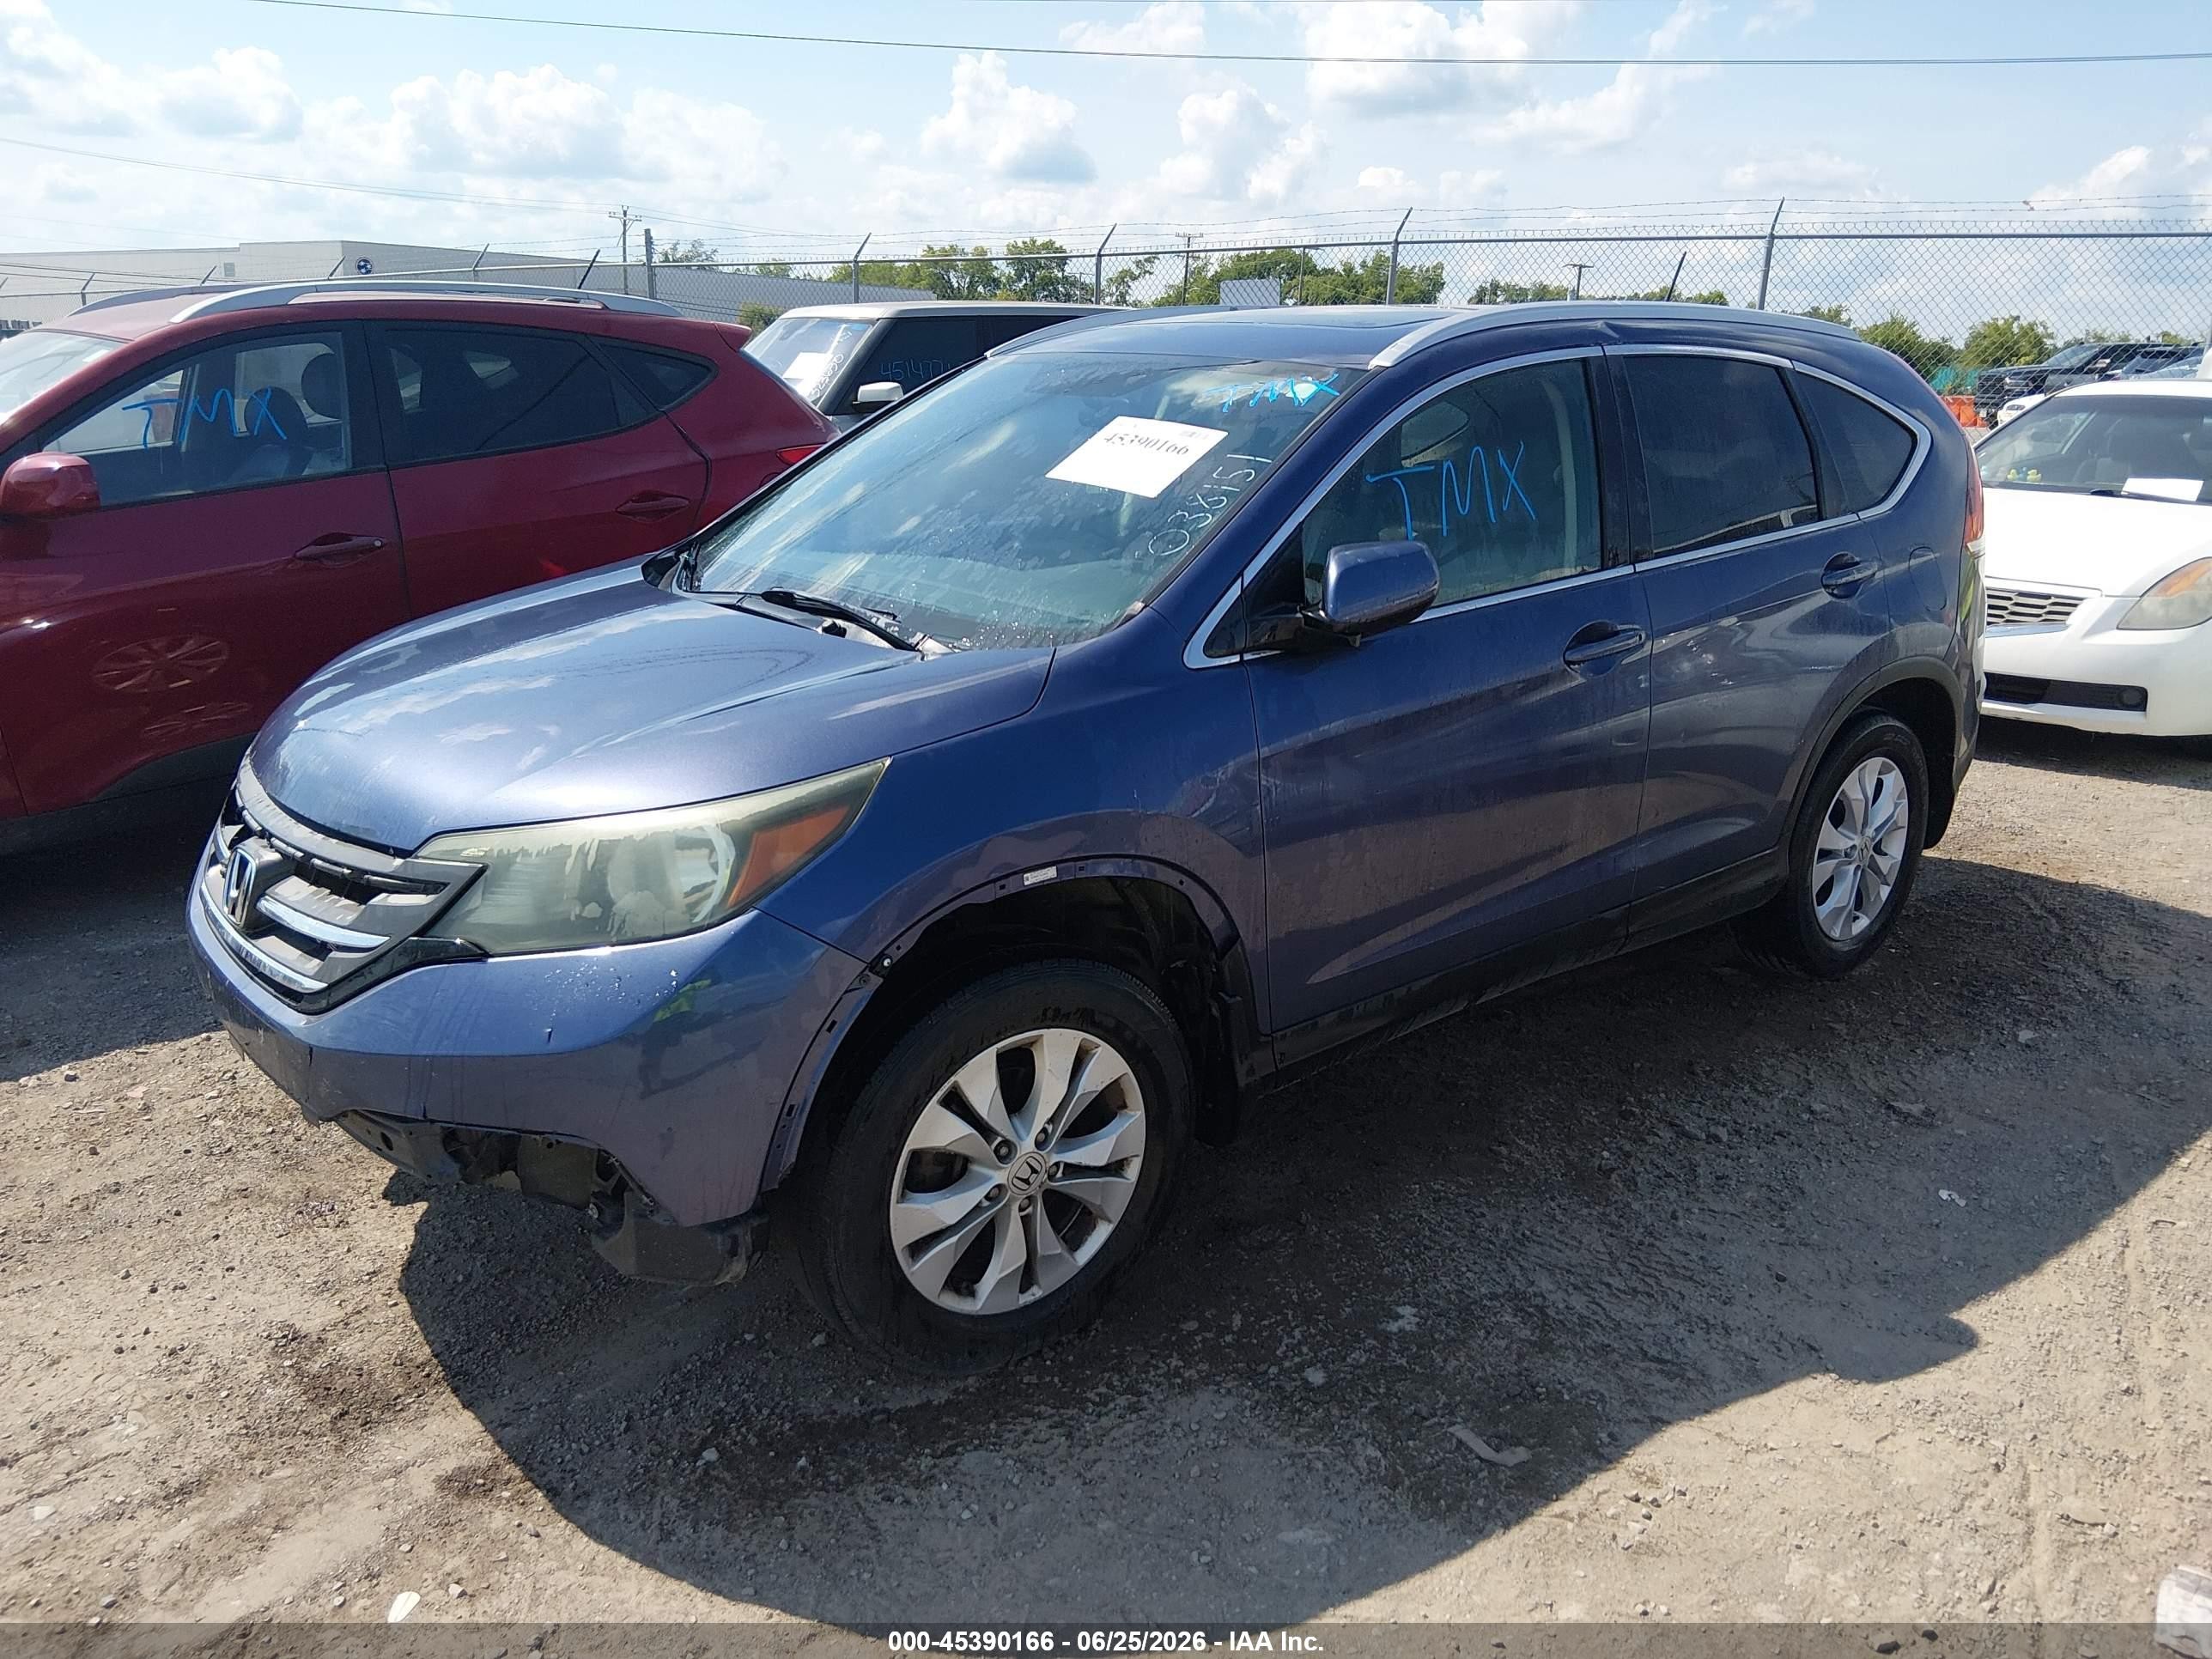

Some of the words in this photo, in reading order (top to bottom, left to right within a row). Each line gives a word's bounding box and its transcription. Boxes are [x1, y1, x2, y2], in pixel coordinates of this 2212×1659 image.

[122, 386, 288, 453] TMX
[1203, 373, 1340, 413] TMX
[1365, 440, 1536, 541] TMX
